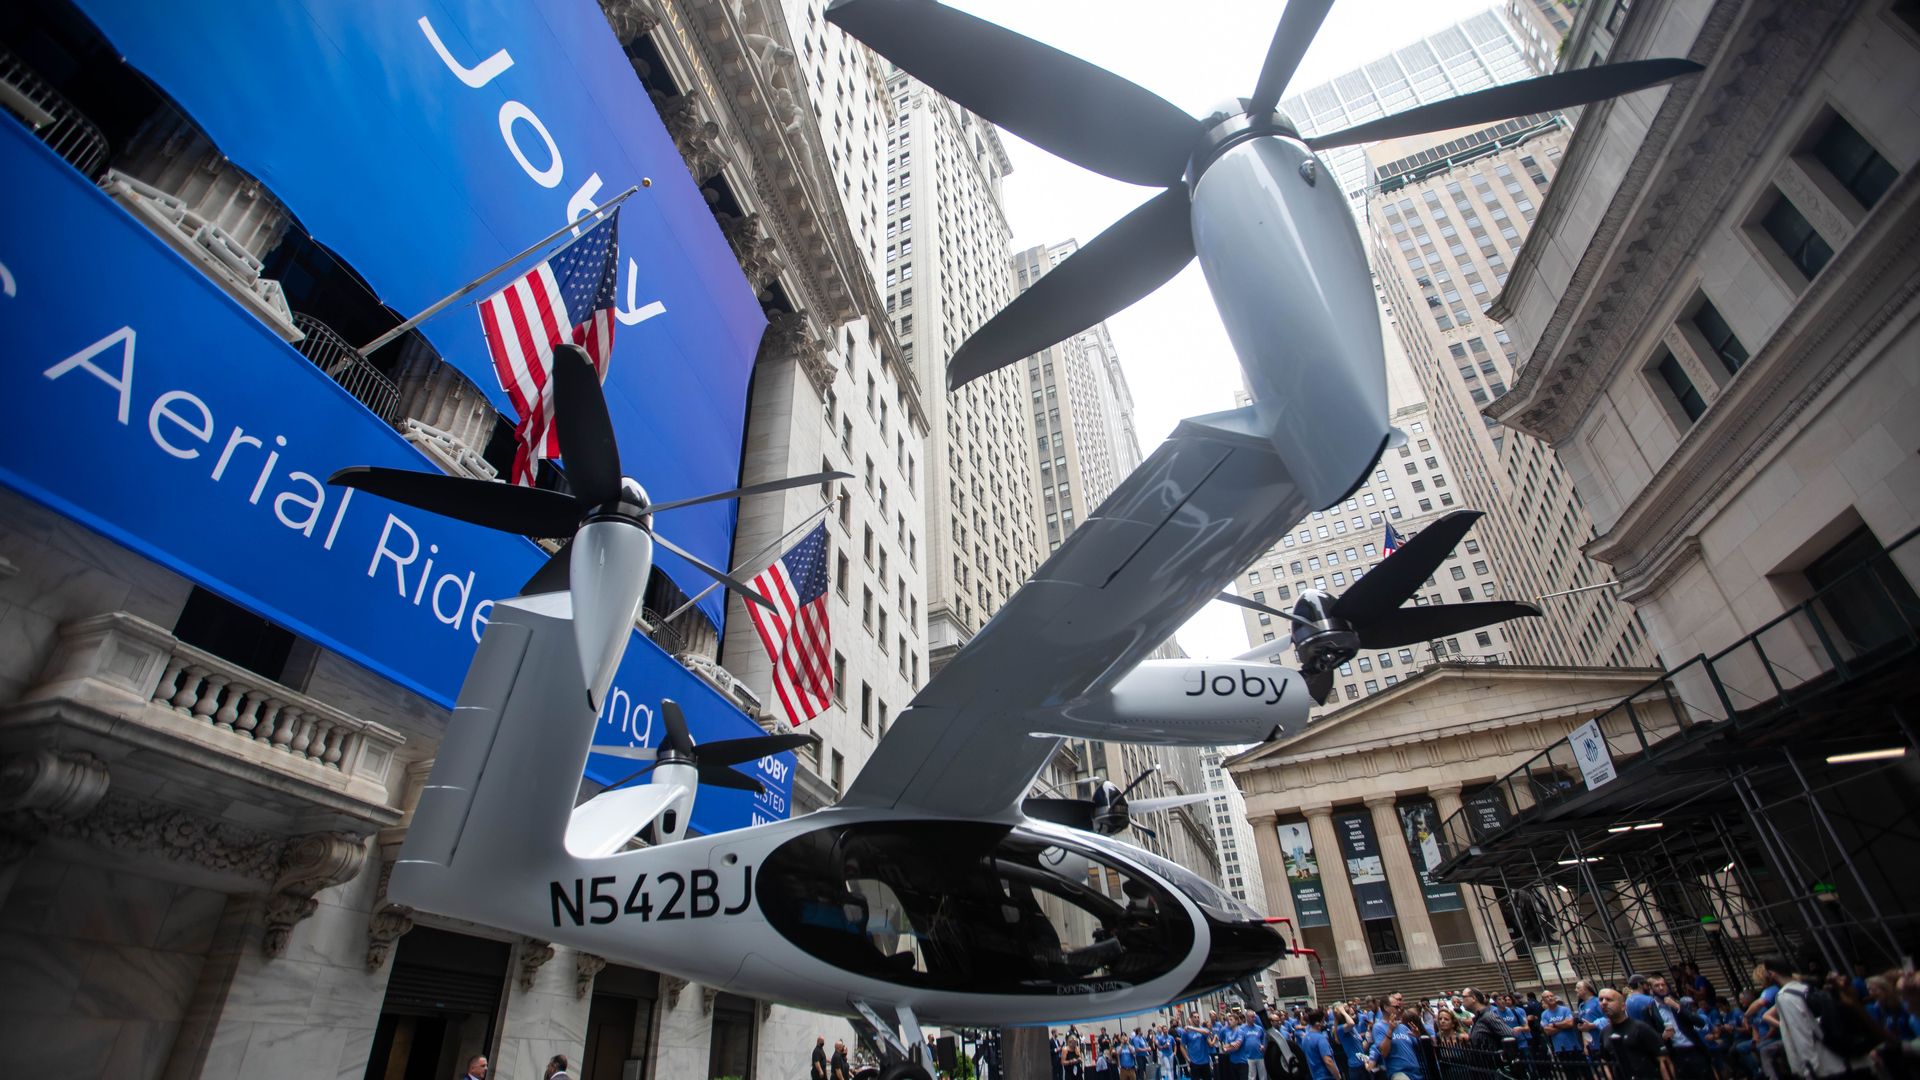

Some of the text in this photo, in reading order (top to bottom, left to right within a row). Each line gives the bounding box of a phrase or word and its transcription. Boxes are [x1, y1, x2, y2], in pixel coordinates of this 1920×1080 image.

[44, 326, 352, 549] Aerial
[1186, 669, 1288, 705] Joby
[757, 755, 788, 784] JOBY
[550, 865, 753, 927] N542BJ
